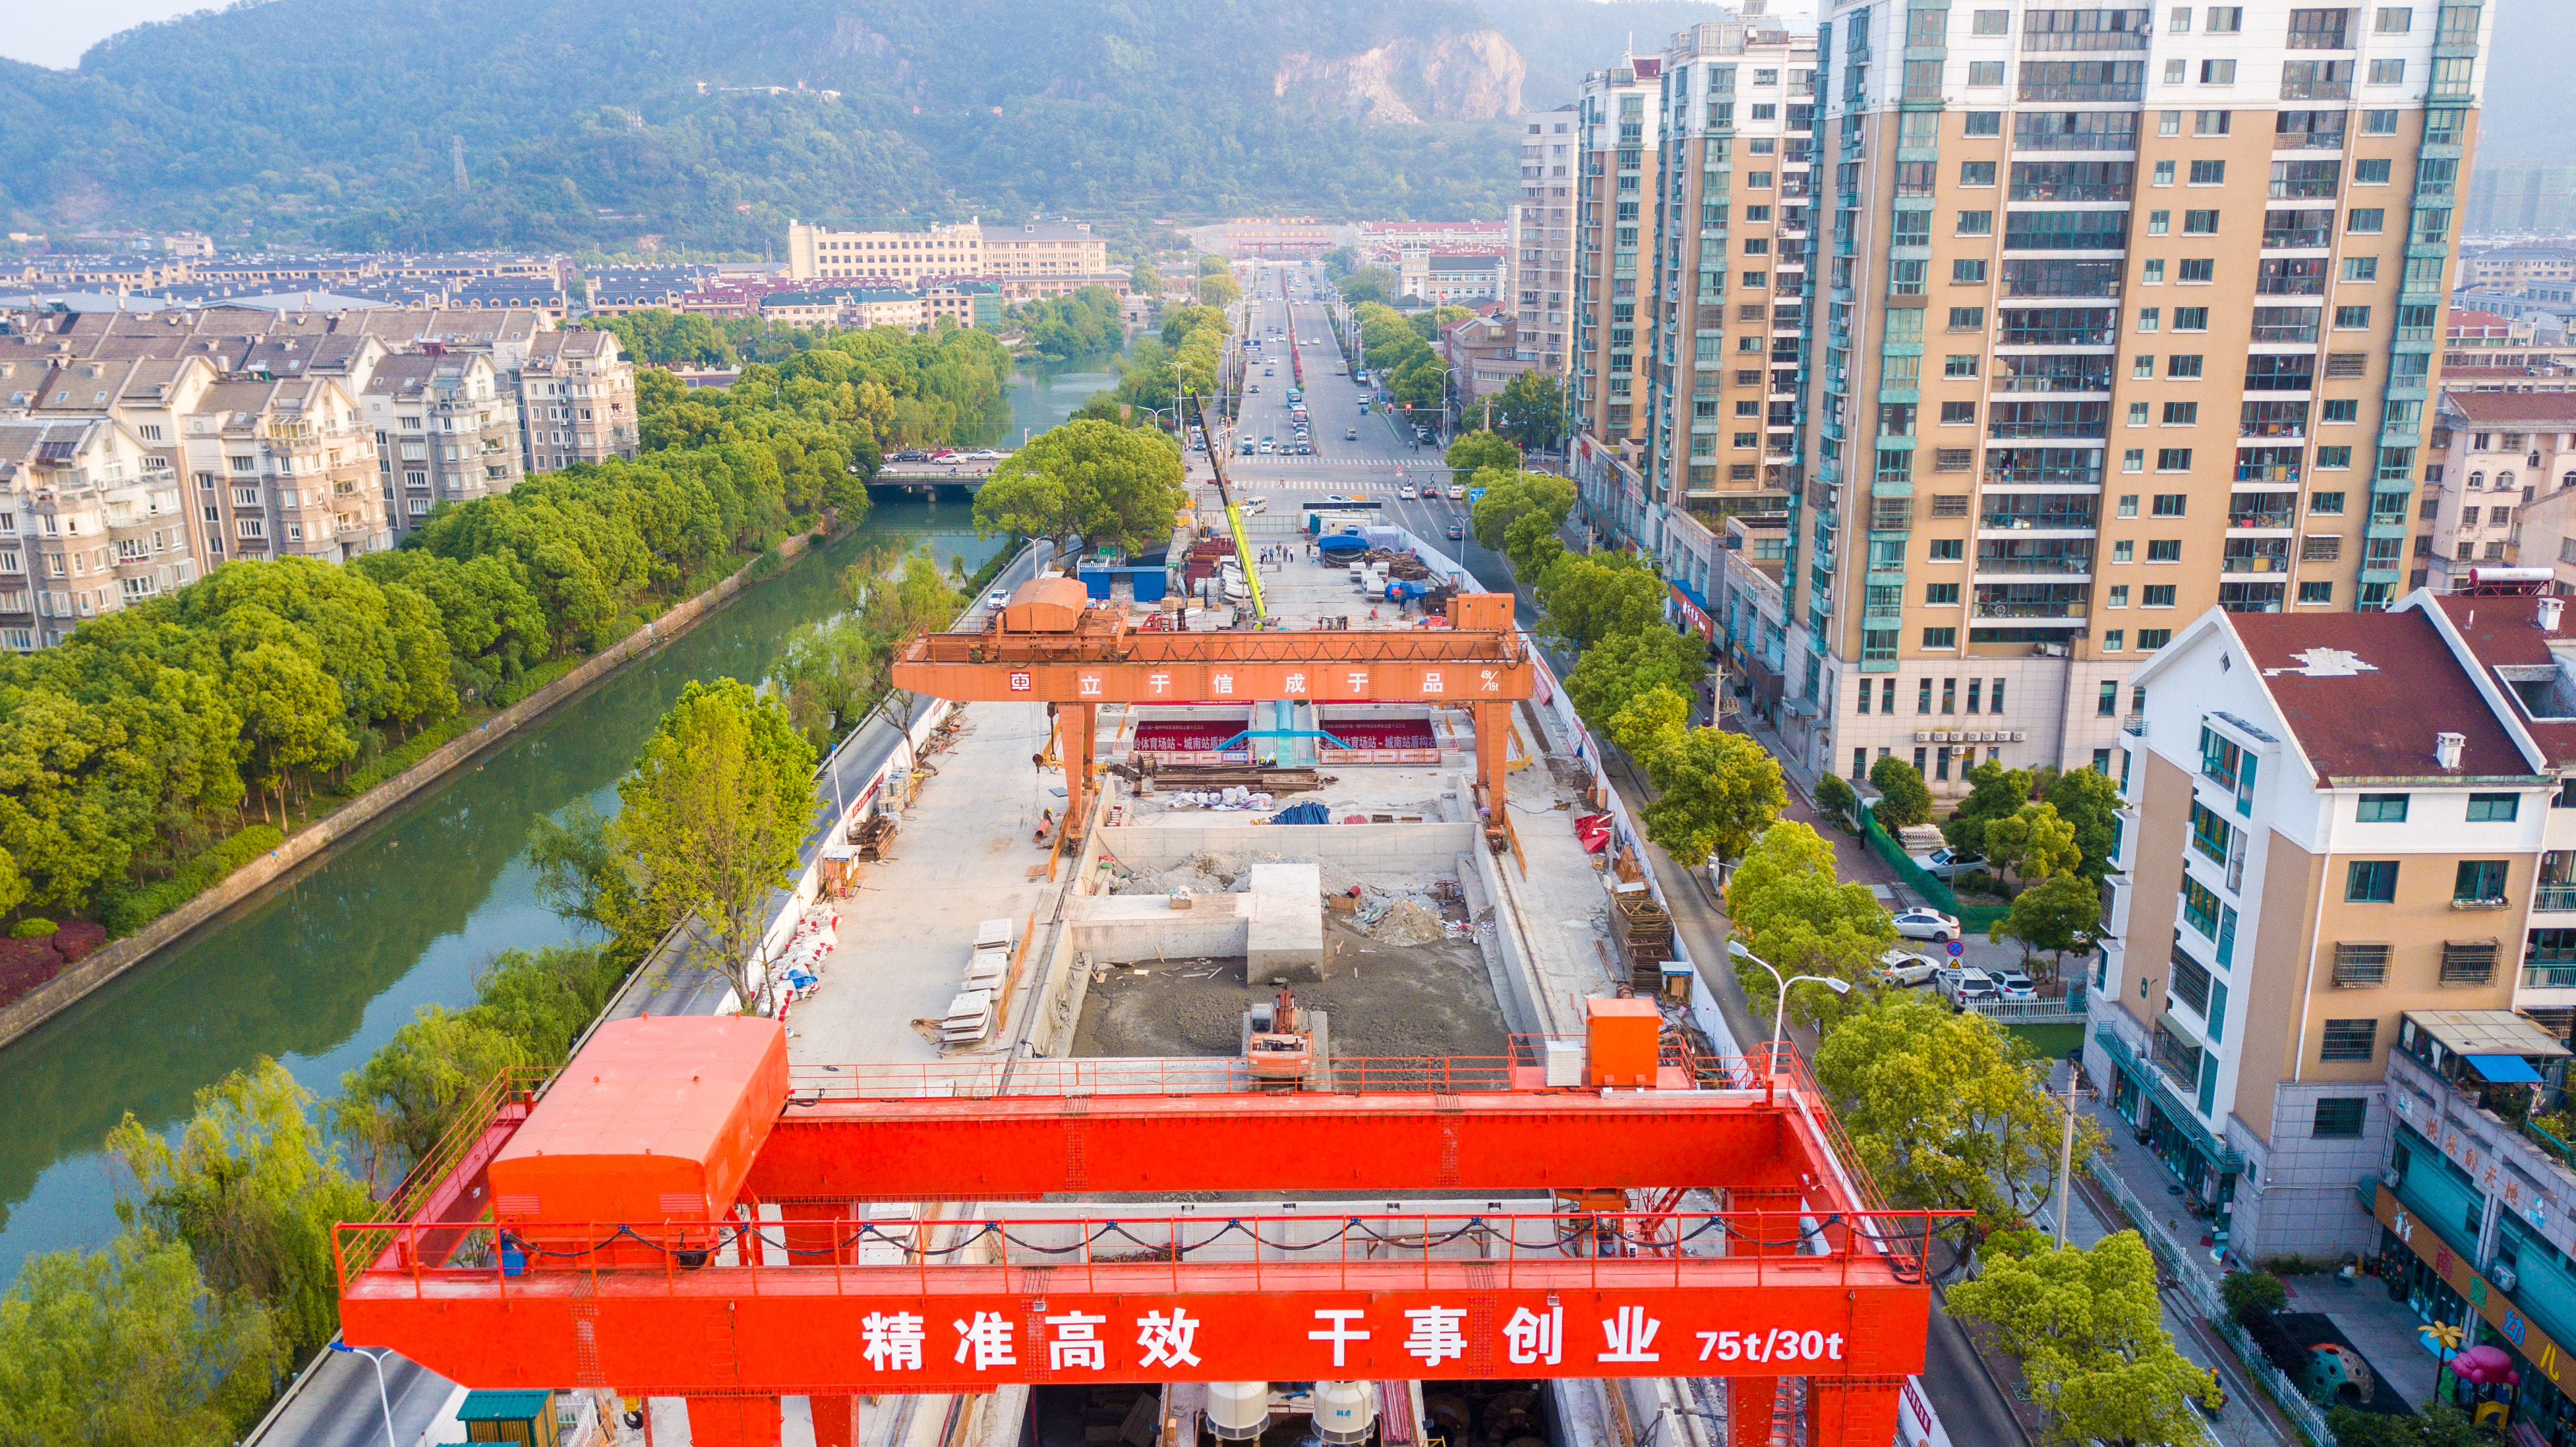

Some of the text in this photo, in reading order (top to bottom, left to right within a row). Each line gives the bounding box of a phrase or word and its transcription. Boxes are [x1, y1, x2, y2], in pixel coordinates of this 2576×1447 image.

[1080, 672, 1444, 696] 立于信成于品
[862, 1305, 1844, 1373] 精准高效 干事创业 75t/30t
